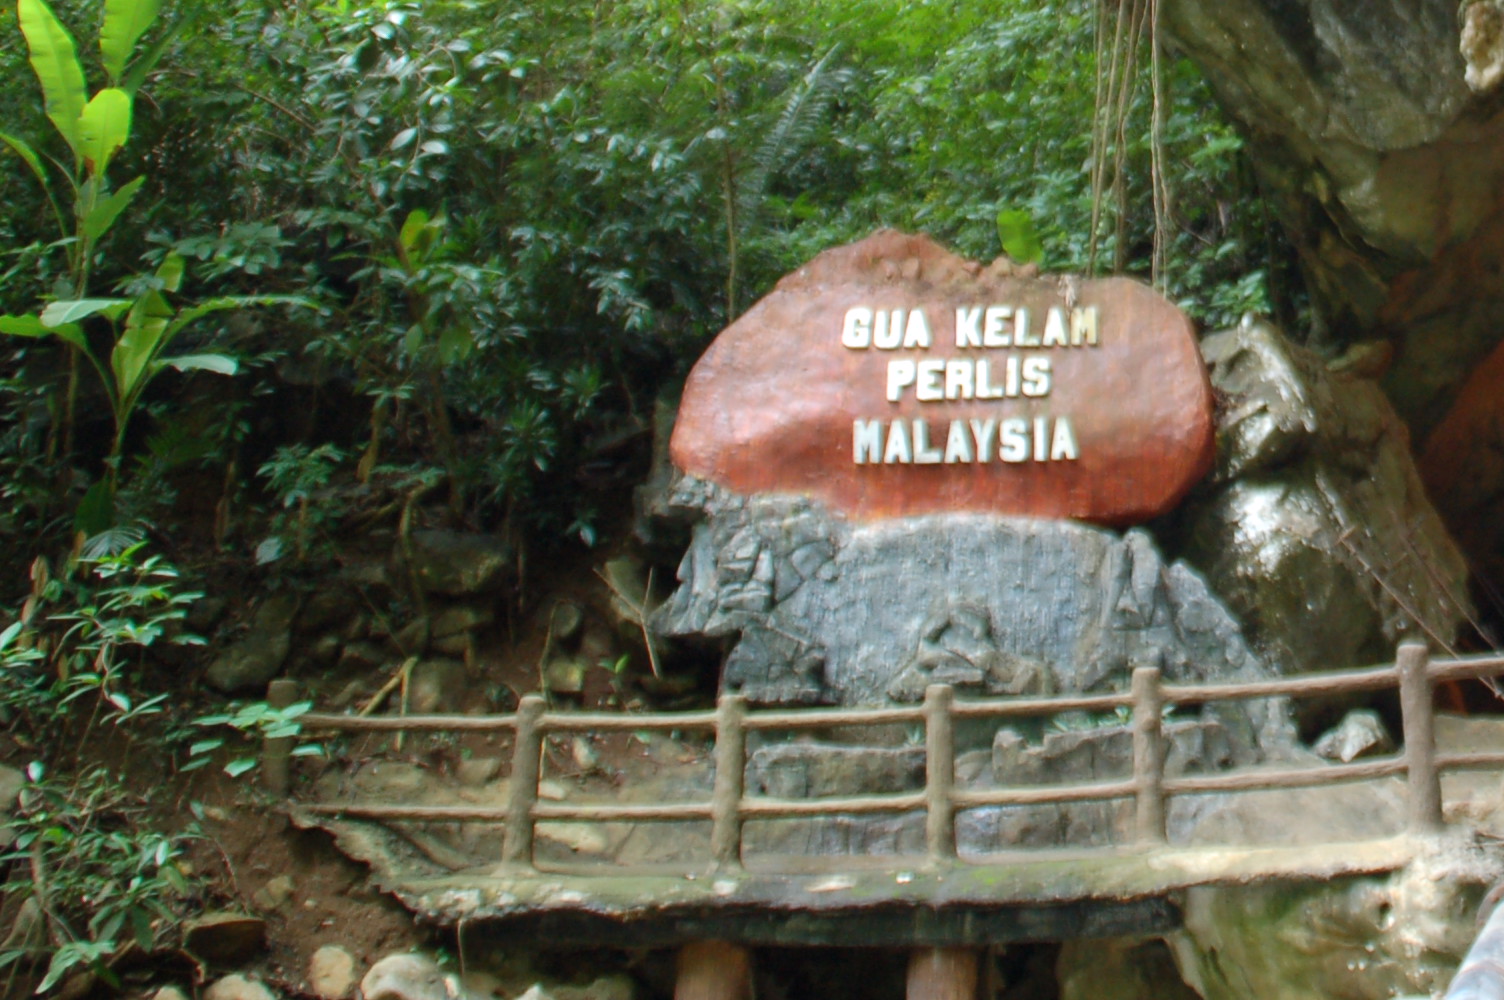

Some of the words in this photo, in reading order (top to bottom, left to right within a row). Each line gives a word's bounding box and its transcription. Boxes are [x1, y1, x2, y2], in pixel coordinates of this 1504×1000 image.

[842, 307, 931, 349] GUA
[955, 306, 1099, 348] KELAM
[886, 357, 1052, 401] PERLIS
[853, 418, 1080, 465] MALAYSIA
